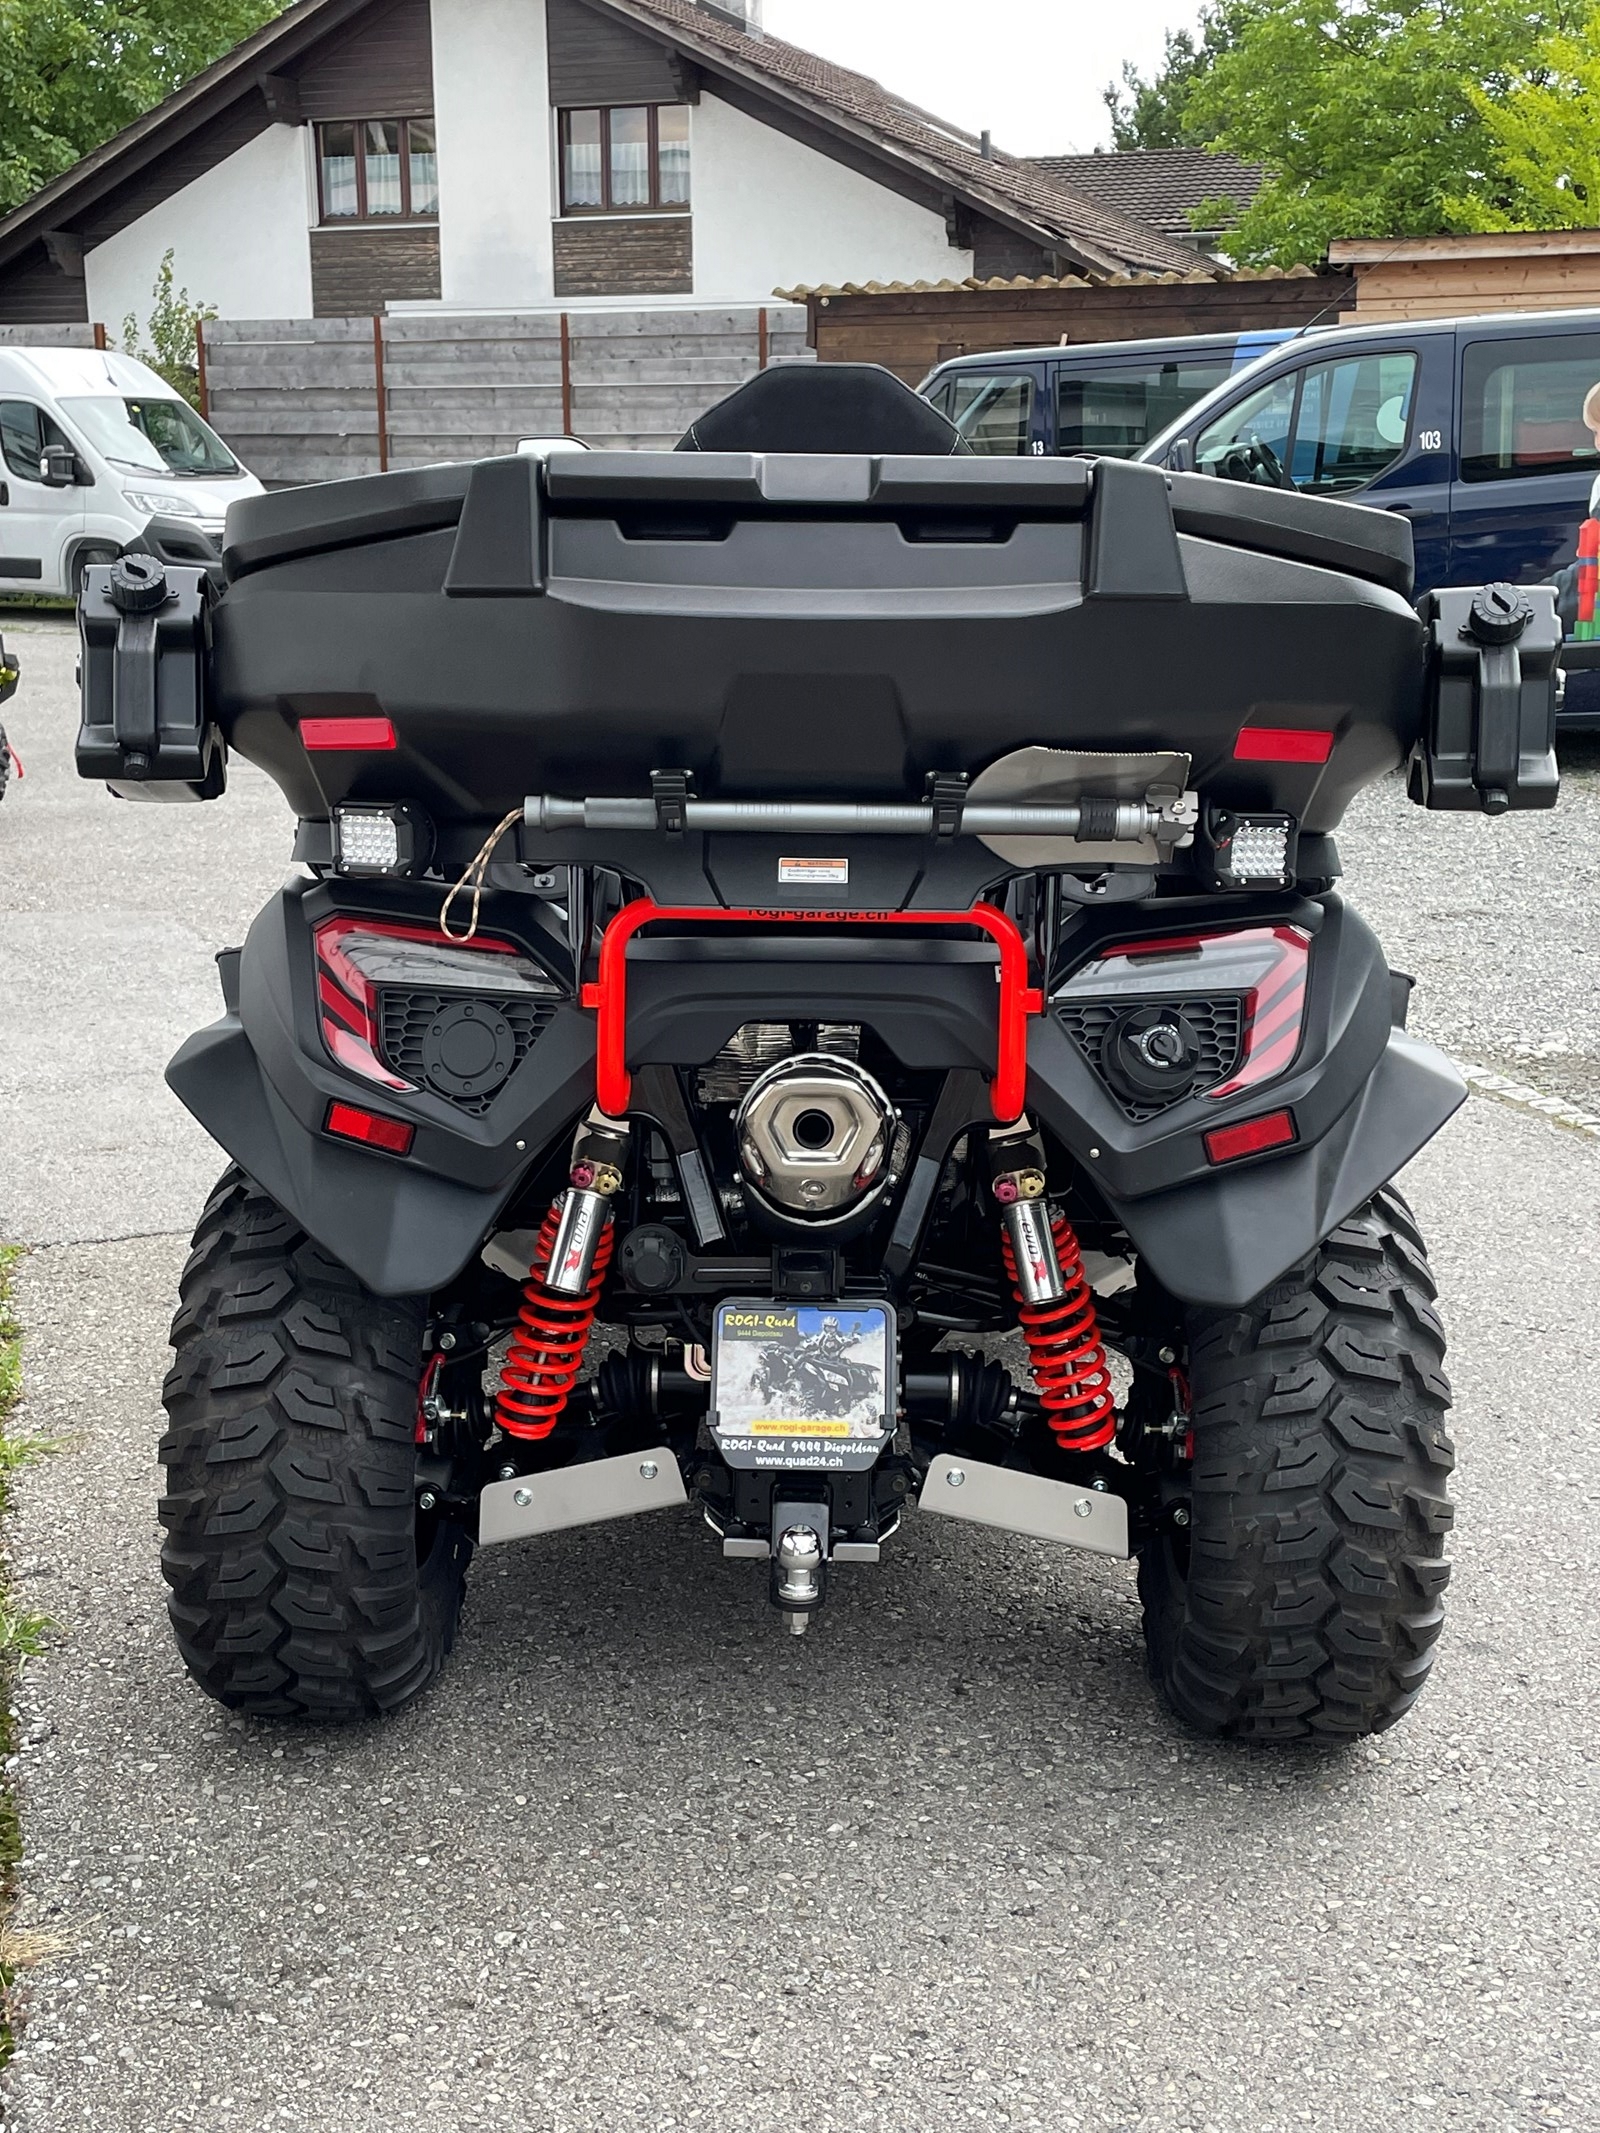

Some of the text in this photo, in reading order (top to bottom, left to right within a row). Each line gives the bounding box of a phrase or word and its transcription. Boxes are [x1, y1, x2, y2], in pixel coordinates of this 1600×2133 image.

[1031, 440, 1044, 455] 13
[1419, 430, 1442, 450] 103
[725, 1314, 796, 1329] ROGI-Quad
[752, 1330, 784, 1338] Diepoldsau
[755, 1422, 847, 1434] www.rogi-garage.ch
[721, 1438, 880, 1456] ROGI-Quad 9444 Diepoldsau
[755, 1456, 844, 1468] www.quad24.ch
